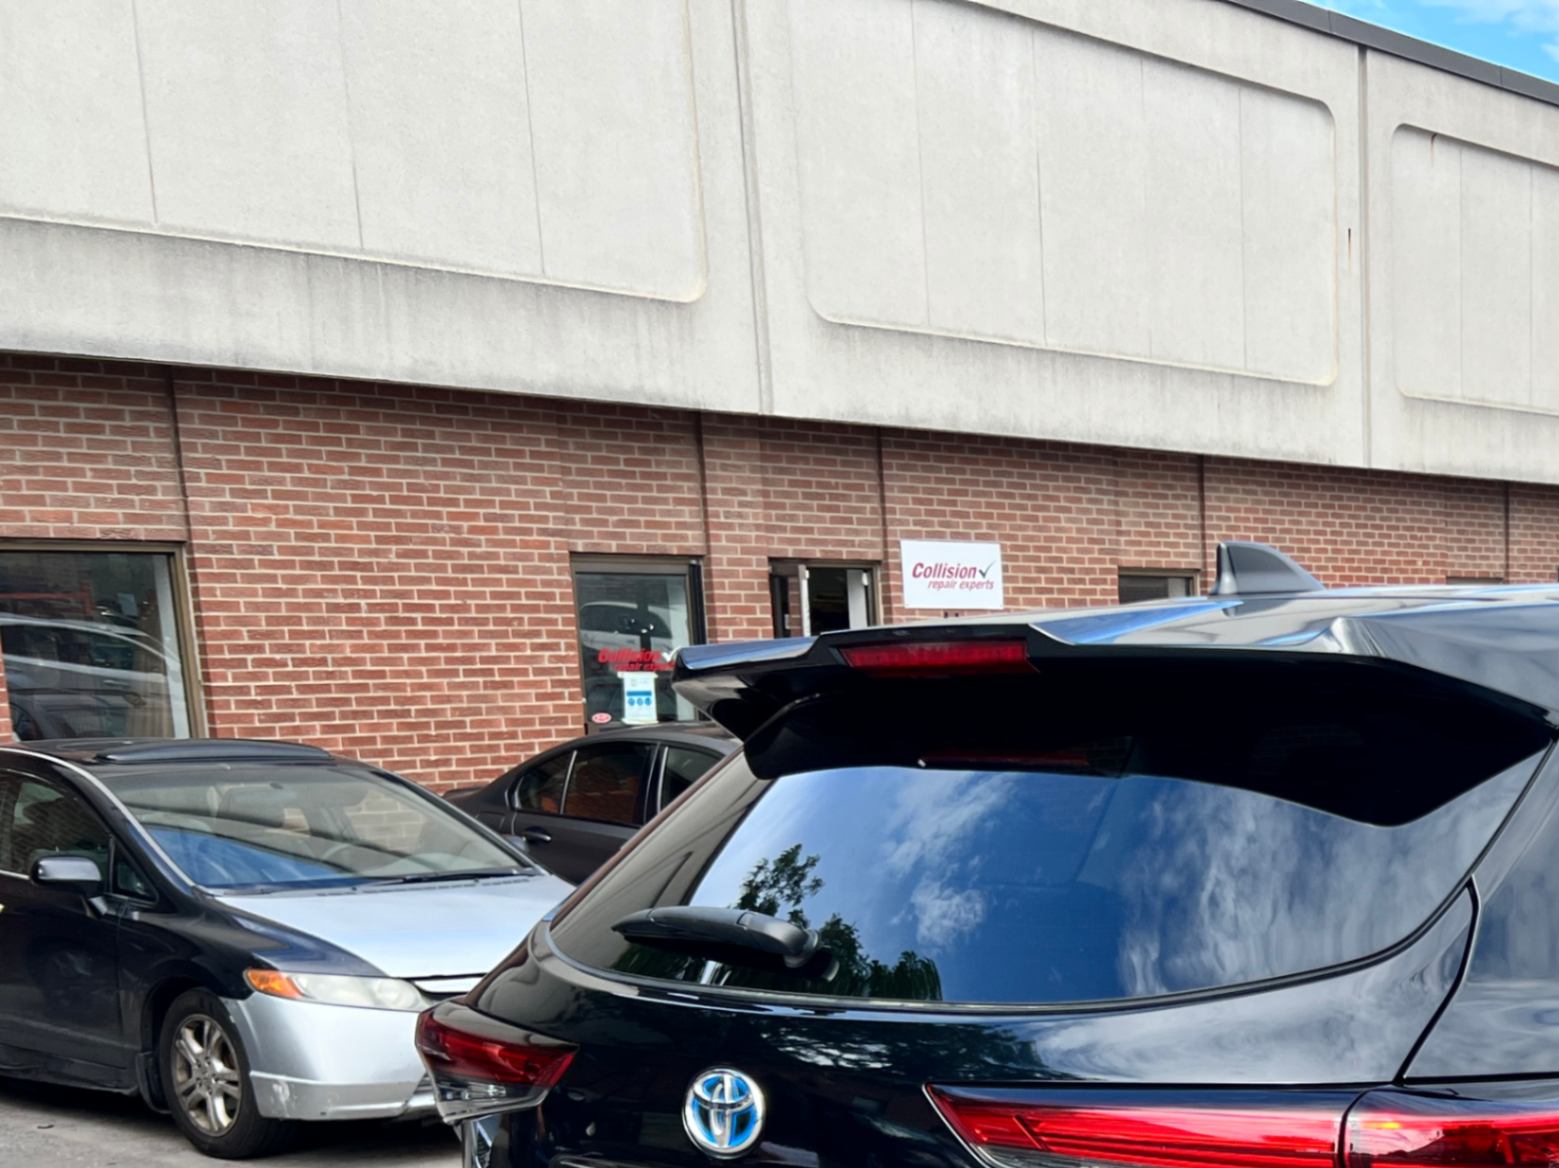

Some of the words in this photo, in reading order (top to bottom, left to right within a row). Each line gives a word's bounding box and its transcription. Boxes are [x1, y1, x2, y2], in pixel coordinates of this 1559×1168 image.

[912, 561, 977, 579] Collision
[928, 580, 957, 591] repair
[959, 579, 995, 591] experts
